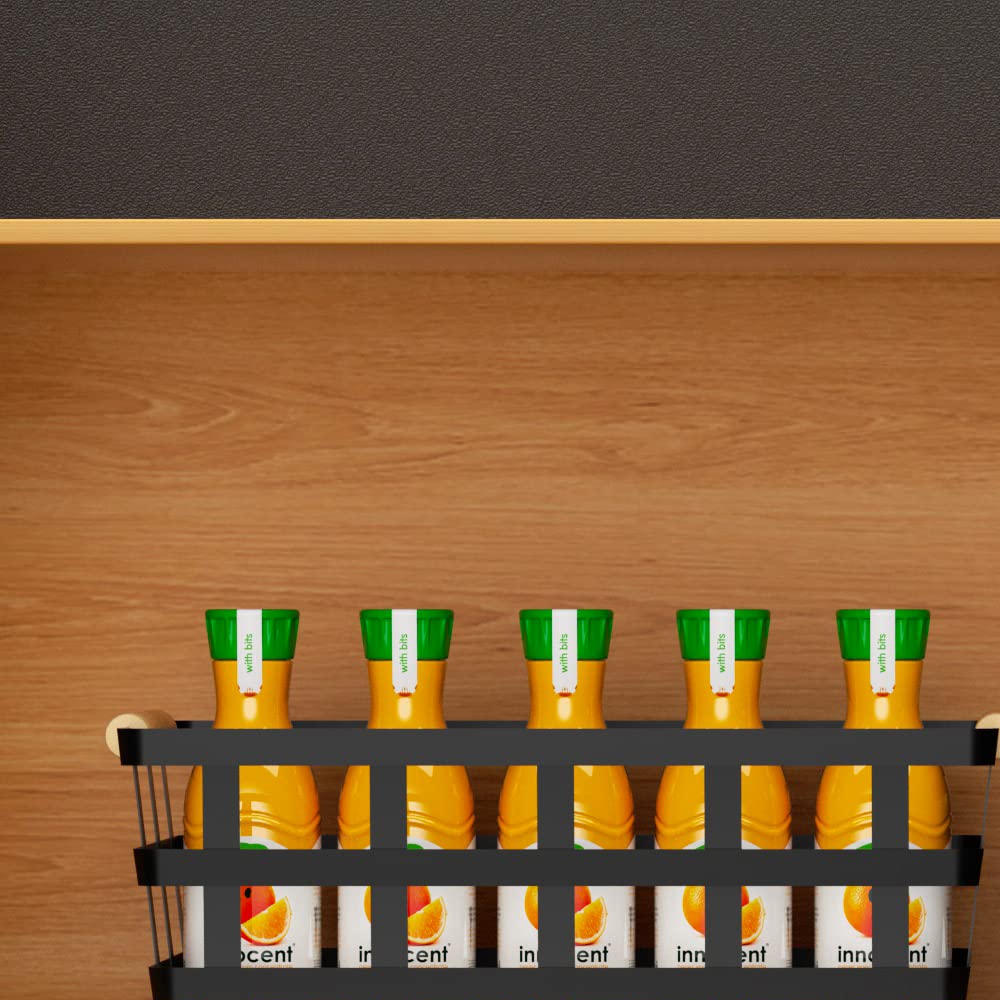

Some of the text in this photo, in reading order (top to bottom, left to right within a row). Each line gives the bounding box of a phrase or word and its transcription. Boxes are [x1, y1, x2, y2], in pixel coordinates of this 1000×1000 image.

[244, 633, 253, 673] with bits
[399, 633, 408, 673] with bits
[559, 633, 569, 673] with bits
[716, 633, 726, 673] with bits
[877, 633, 887, 673] with bits
